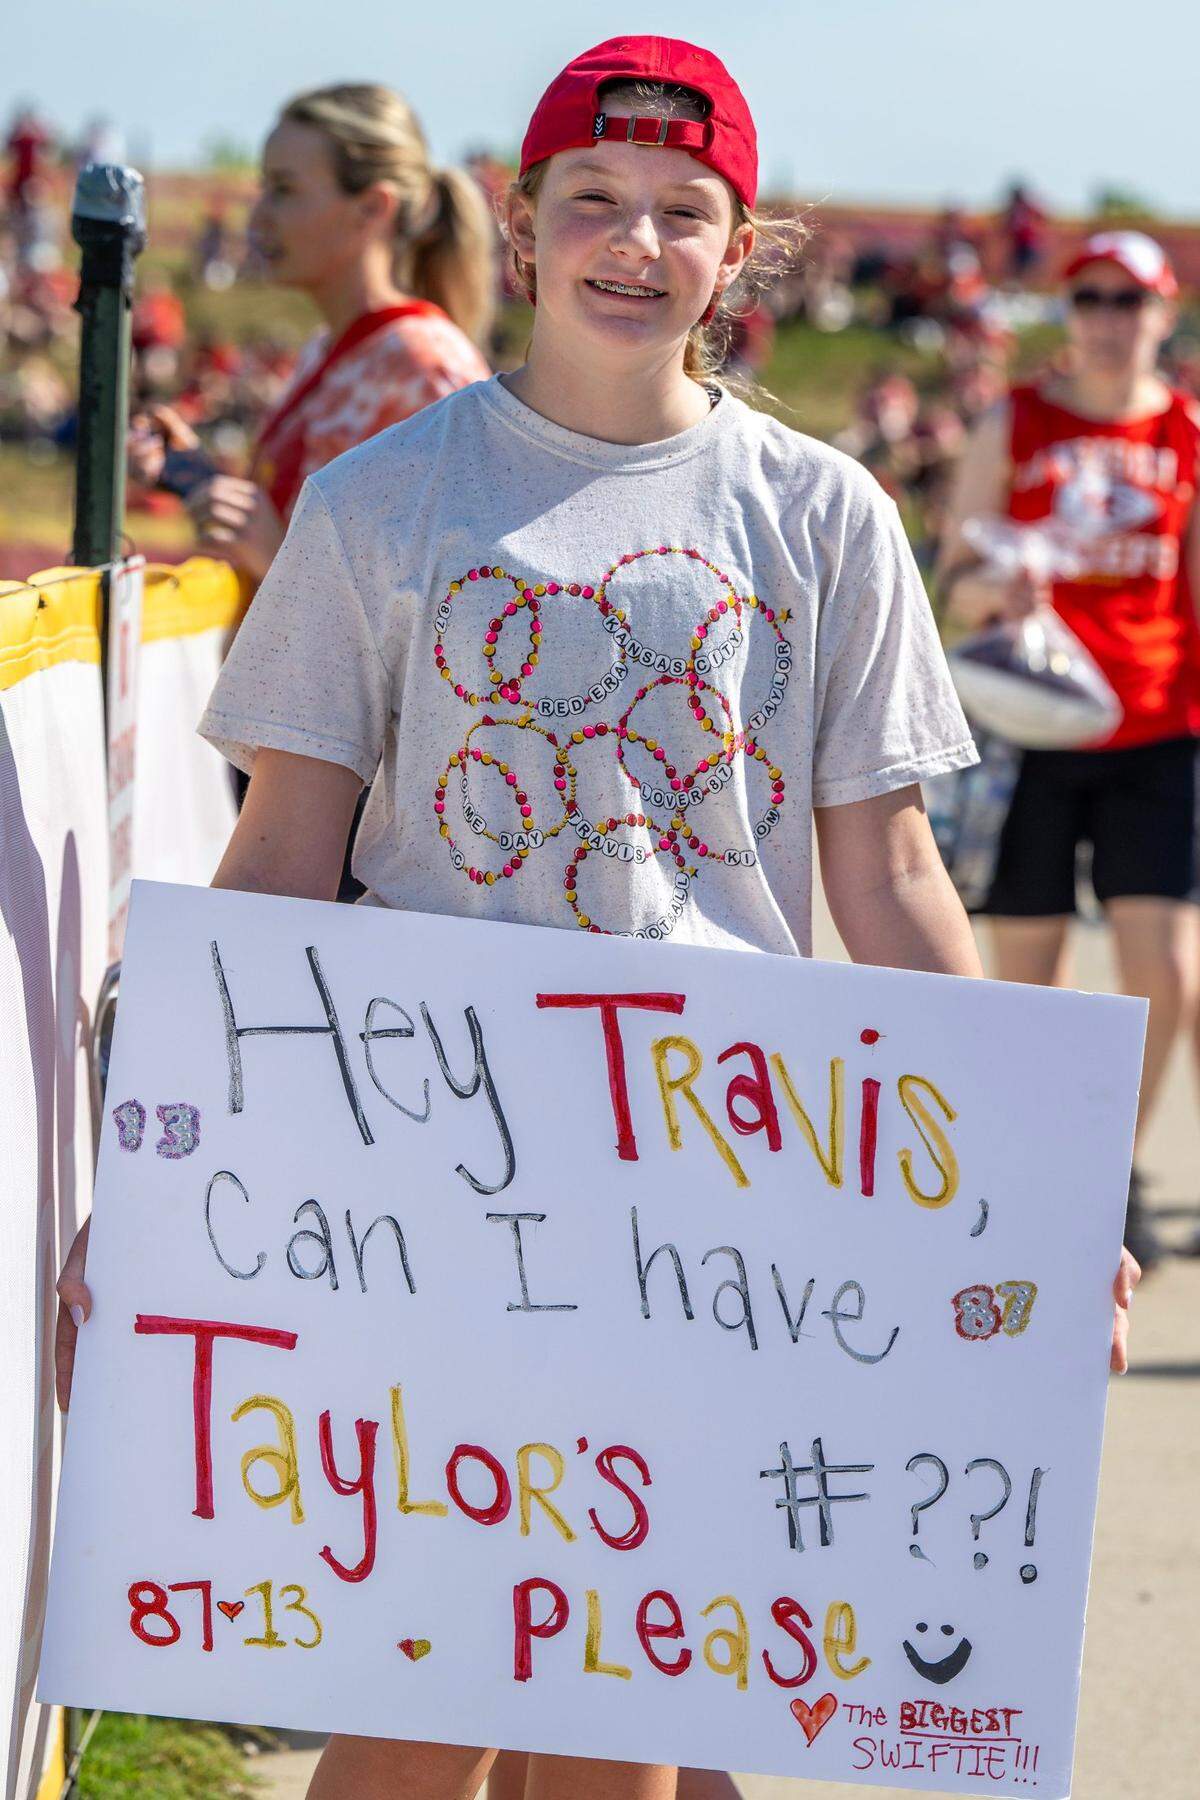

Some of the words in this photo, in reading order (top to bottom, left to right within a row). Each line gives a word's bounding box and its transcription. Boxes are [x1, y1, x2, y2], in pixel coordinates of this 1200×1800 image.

[436, 602, 451, 632] 87
[605, 617, 685, 674] KANSAS
[697, 630, 742, 673] CITY
[540, 697, 584, 715] RED
[590, 663, 627, 701] ERA
[751, 642, 790, 728] TAYLOR
[641, 784, 702, 808] LOVER
[708, 765, 732, 792] 87
[500, 831, 542, 849] DAY
[569, 810, 644, 862] TRAVIS
[211, 940, 516, 1195] Hey
[113, 1098, 200, 1159] 13
[205, 1170, 416, 1294] Can
[486, 1213, 578, 1312] I
[631, 1206, 899, 1364] have
[952, 1280, 1038, 1341] 87
[128, 1580, 213, 1652] 87
[243, 1579, 323, 1650] 13
[843, 1703, 887, 1728] The
[900, 1700, 1022, 1737] BIGGEST
[853, 1737, 1039, 1785] SWIFTIE!!!
